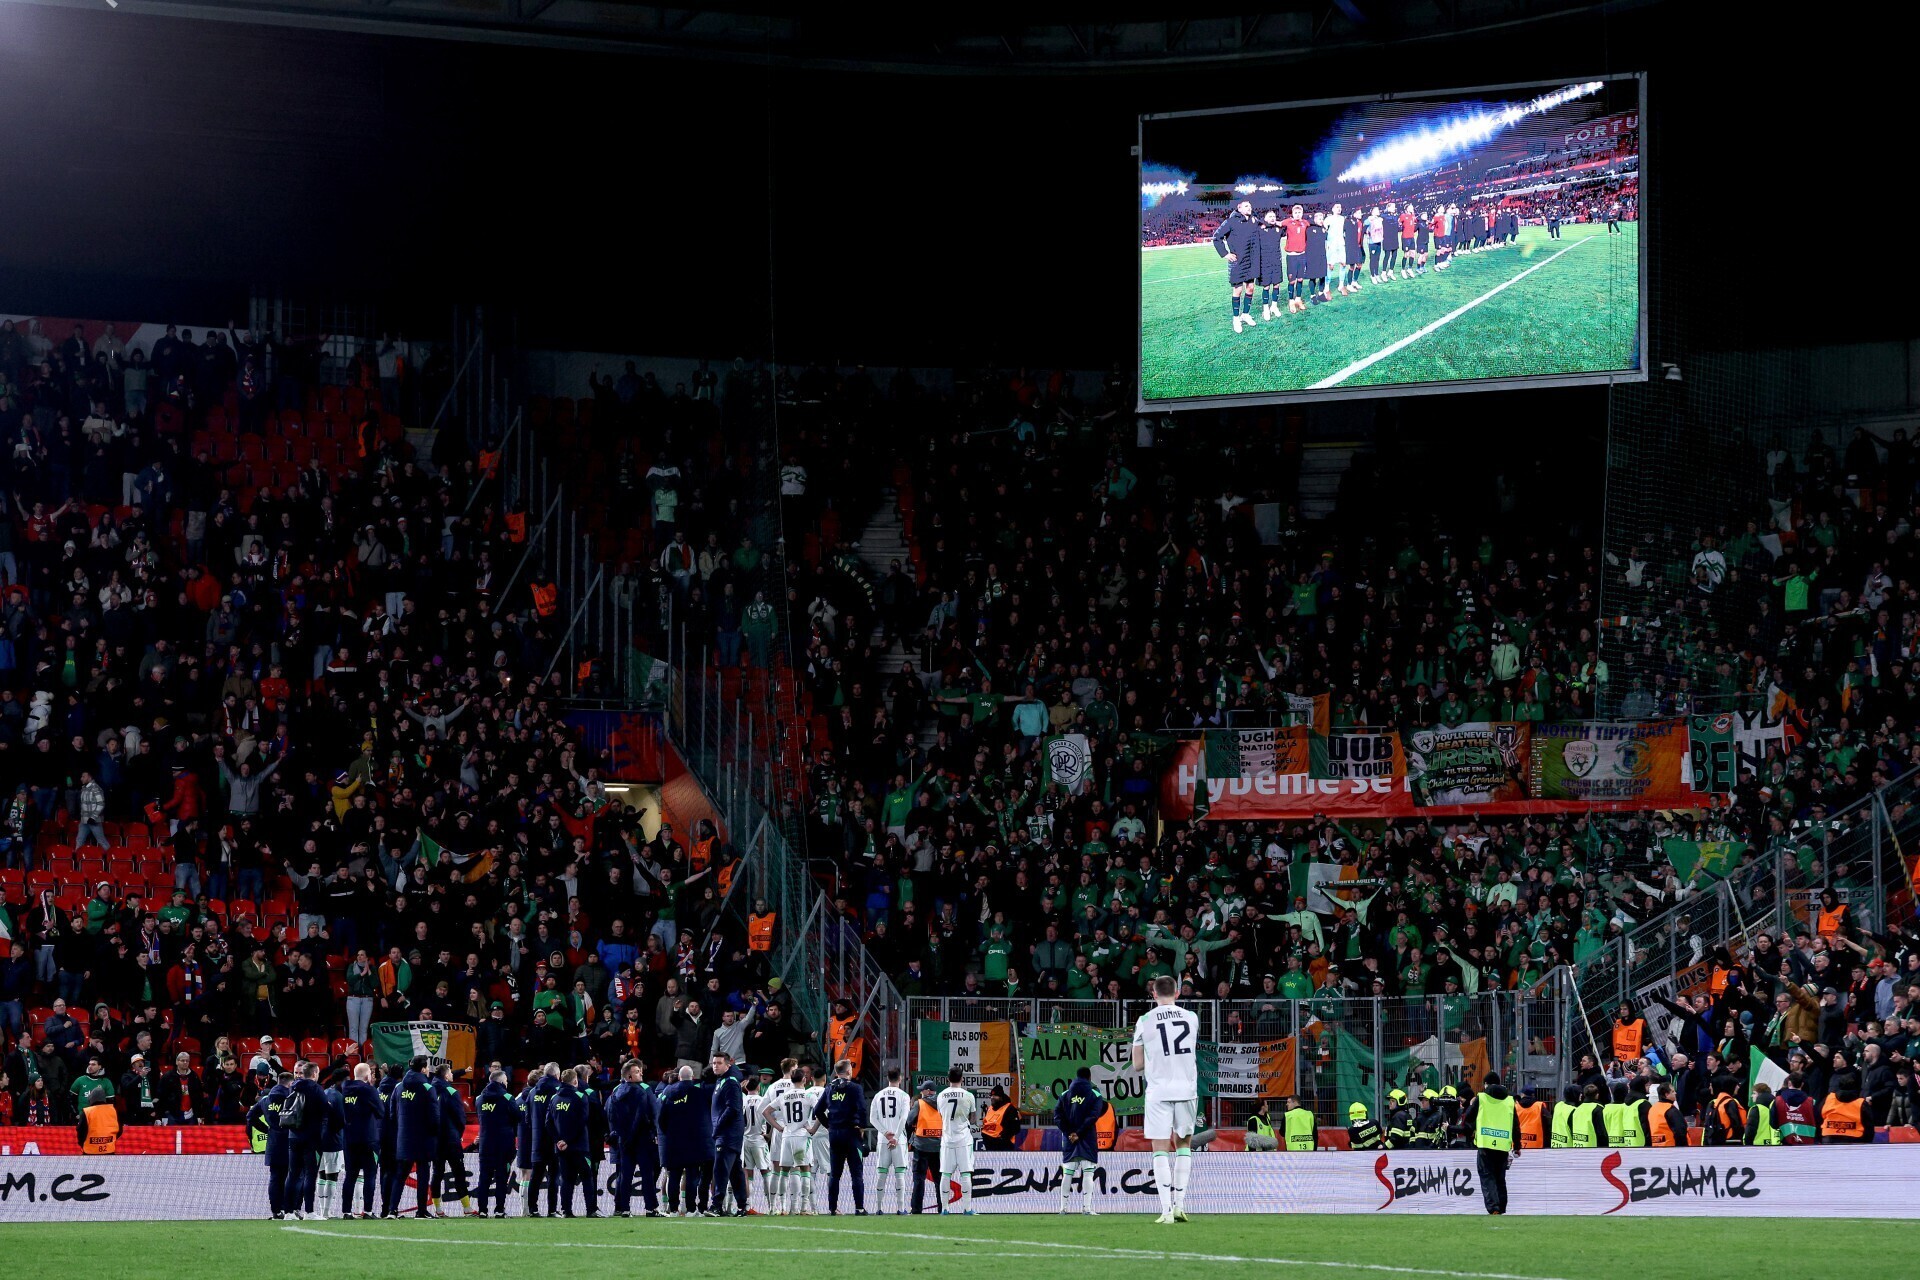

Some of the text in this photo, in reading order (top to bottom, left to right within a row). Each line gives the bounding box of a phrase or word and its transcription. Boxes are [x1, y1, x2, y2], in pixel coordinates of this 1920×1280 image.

[1221, 730, 1295, 743] YOUGHAL
[1435, 730, 1494, 742] YOU'LL NEVER
[1537, 722, 1590, 740] NORTH
[1437, 739, 1490, 750] BEAT THE
[1431, 746, 1502, 770] IRISH
[1328, 761, 1393, 777] ON TOUR
[1456, 766, 1471, 774] THE
[1427, 774, 1505, 790] Charlie and Grandad
[1463, 784, 1491, 794] On Tour
[170, 917, 183, 925] sky
[1285, 981, 1297, 989] sky
[1156, 1009, 1184, 1021] DUNNE
[942, 1031, 988, 1041] EARLS BOYS
[1156, 1021, 1192, 1057] 12
[957, 1046, 969, 1057] ON
[1030, 1038, 1087, 1061] ALAN
[1240, 1046, 1268, 1055] SOUTH
[1270, 1042, 1287, 1052] MEN
[1003, 1076, 1015, 1088] OF
[1100, 1075, 1144, 1101] TOU
[1208, 1083, 1268, 1094] COMRADES ALL
[344, 1095, 358, 1106] sky
[401, 1089, 416, 1101] sky
[533, 1093, 547, 1104] sky
[832, 1092, 846, 1103] sky
[1071, 1095, 1085, 1105] sky
[268, 1102, 282, 1113] sky
[481, 1102, 496, 1113] sky
[556, 1101, 571, 1112] sky
[880, 1096, 897, 1119] 13
[947, 1098, 958, 1121] 7
[785, 1101, 804, 1124] 18
[1828, 1121, 1856, 1129] SECURITY
[925, 1129, 942, 1137] SECURI
[1482, 1127, 1509, 1138] STRETCHER
[1521, 1133, 1535, 1141] URITY
[91, 1136, 113, 1145] SECURITY
[1491, 1139, 1497, 1147] 4
[98, 1145, 107, 1153] 82
[1375, 1153, 1475, 1212] SEZNAM.CZ
[1601, 1151, 1761, 1215] SEZNAM.CZ
